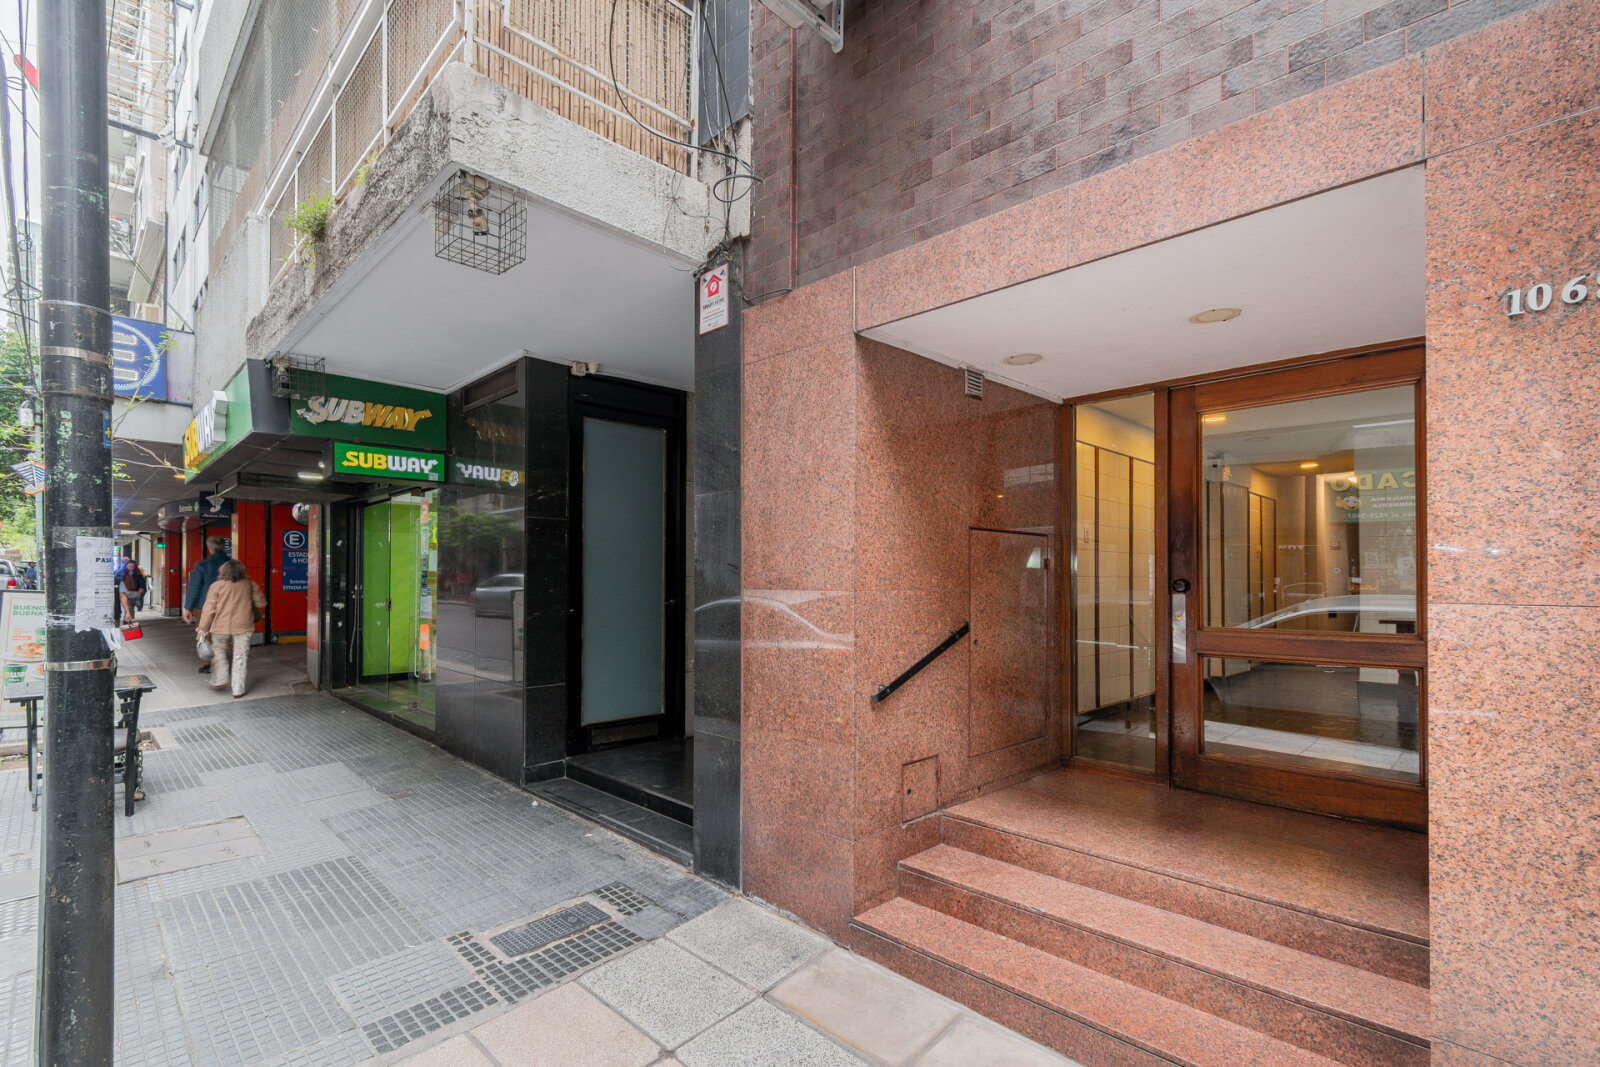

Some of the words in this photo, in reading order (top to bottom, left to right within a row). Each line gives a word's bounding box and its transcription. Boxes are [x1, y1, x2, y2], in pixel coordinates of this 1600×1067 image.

[296, 396, 433, 431] SUBWAY
[341, 451, 438, 473] SUBWAY
[289, 534, 300, 546] E
